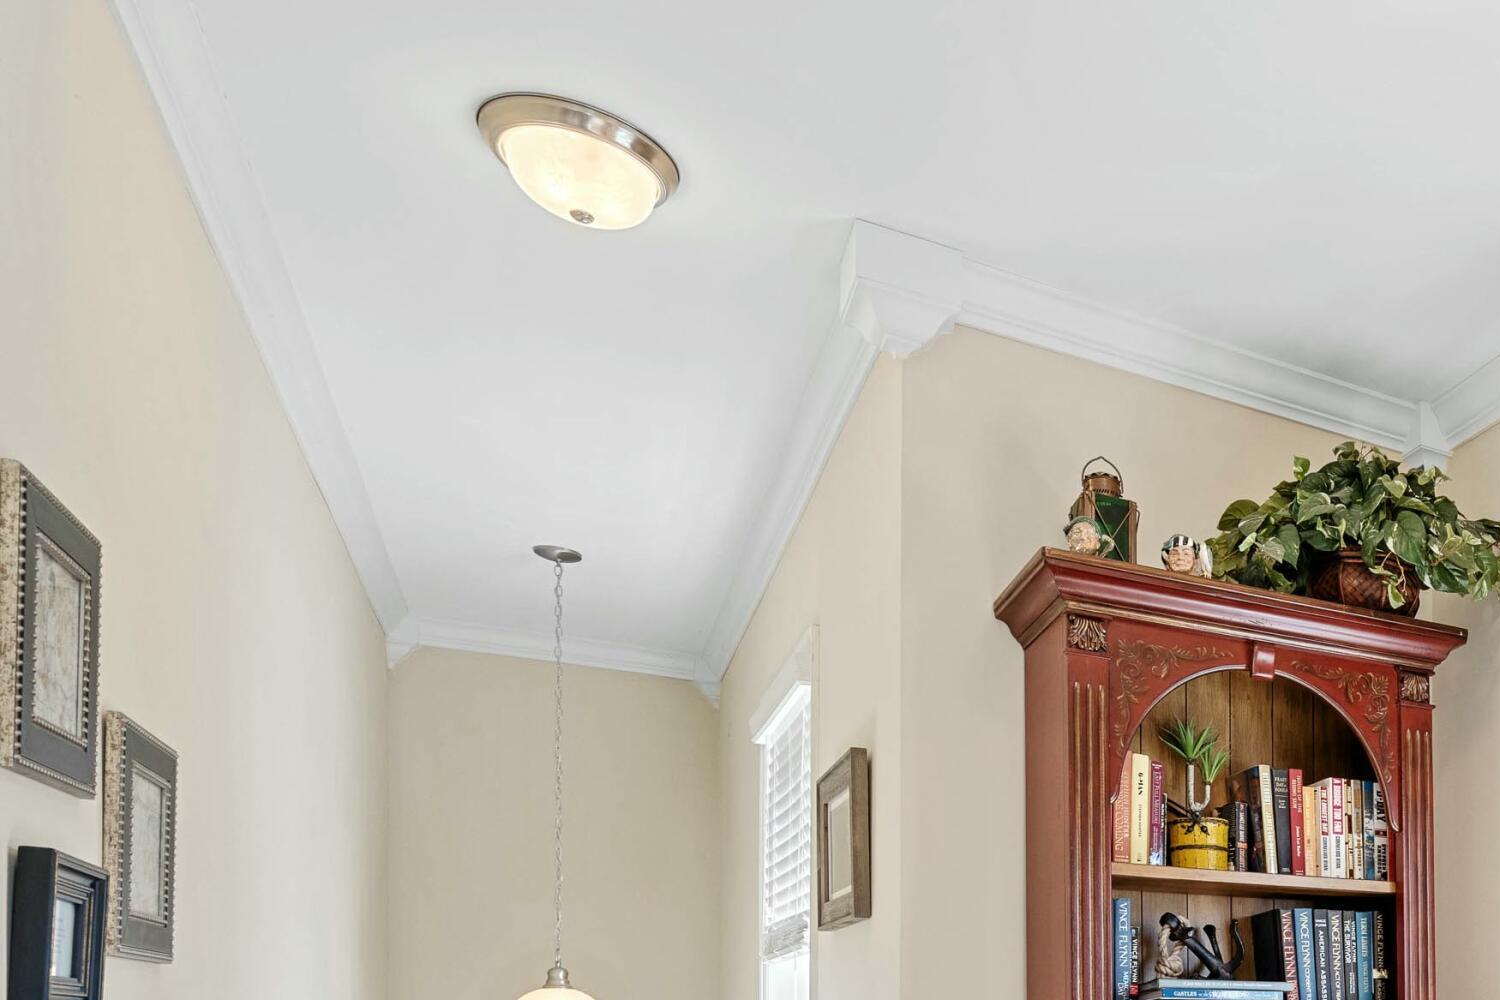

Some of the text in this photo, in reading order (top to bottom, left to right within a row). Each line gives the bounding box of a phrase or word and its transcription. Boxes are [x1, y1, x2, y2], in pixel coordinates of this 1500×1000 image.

[1115, 811, 1123, 851] COMING
[1119, 902, 1128, 967] VINCE FLYNN
[1282, 912, 1291, 942] VINCE
[1300, 912, 1309, 939] VINCE
[1331, 915, 1340, 942] VINCE
[1285, 946, 1296, 977] FLYNN
[1302, 941, 1311, 968] FLYNN
[1318, 930, 1326, 967] AMERICAN
[1332, 943, 1341, 970] FLYNN
